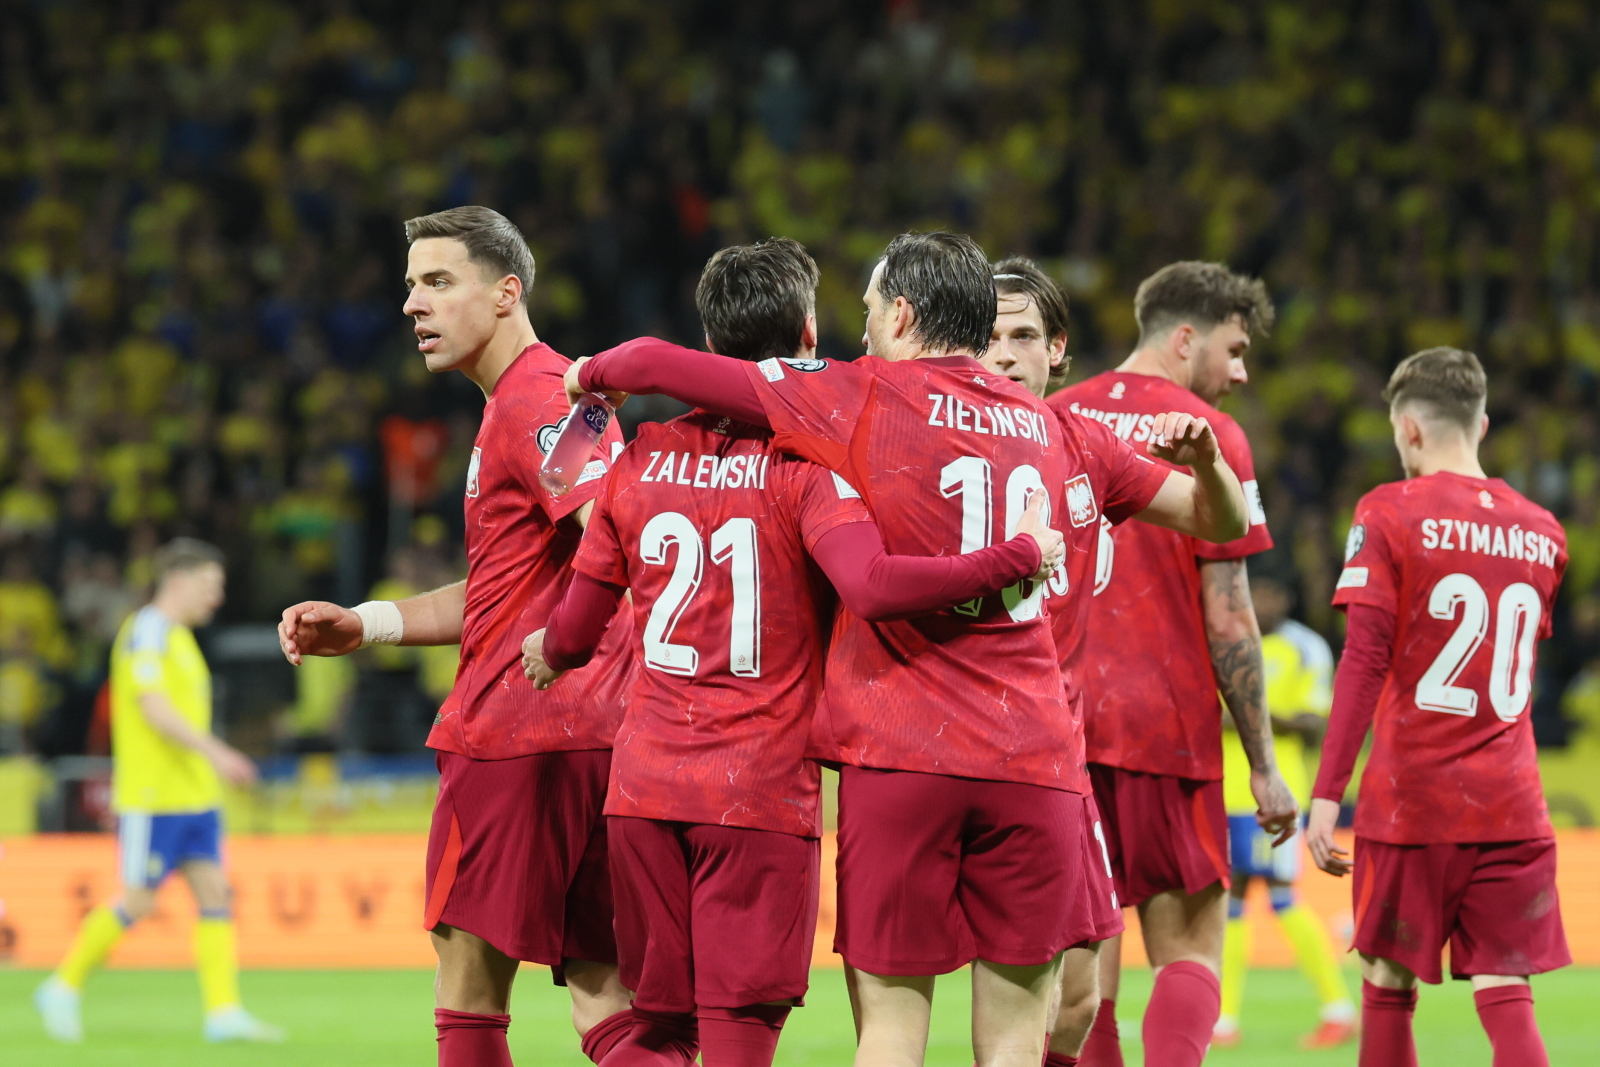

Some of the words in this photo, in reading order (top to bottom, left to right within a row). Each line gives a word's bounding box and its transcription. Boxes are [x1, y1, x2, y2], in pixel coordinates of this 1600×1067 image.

[928, 394, 1049, 447] ZIELIŃSKI
[640, 451, 768, 490] ZALEWSKI
[1421, 518, 1559, 569] SZYMAŃSKI
[640, 511, 760, 678] 21
[1415, 573, 1542, 722] 20
